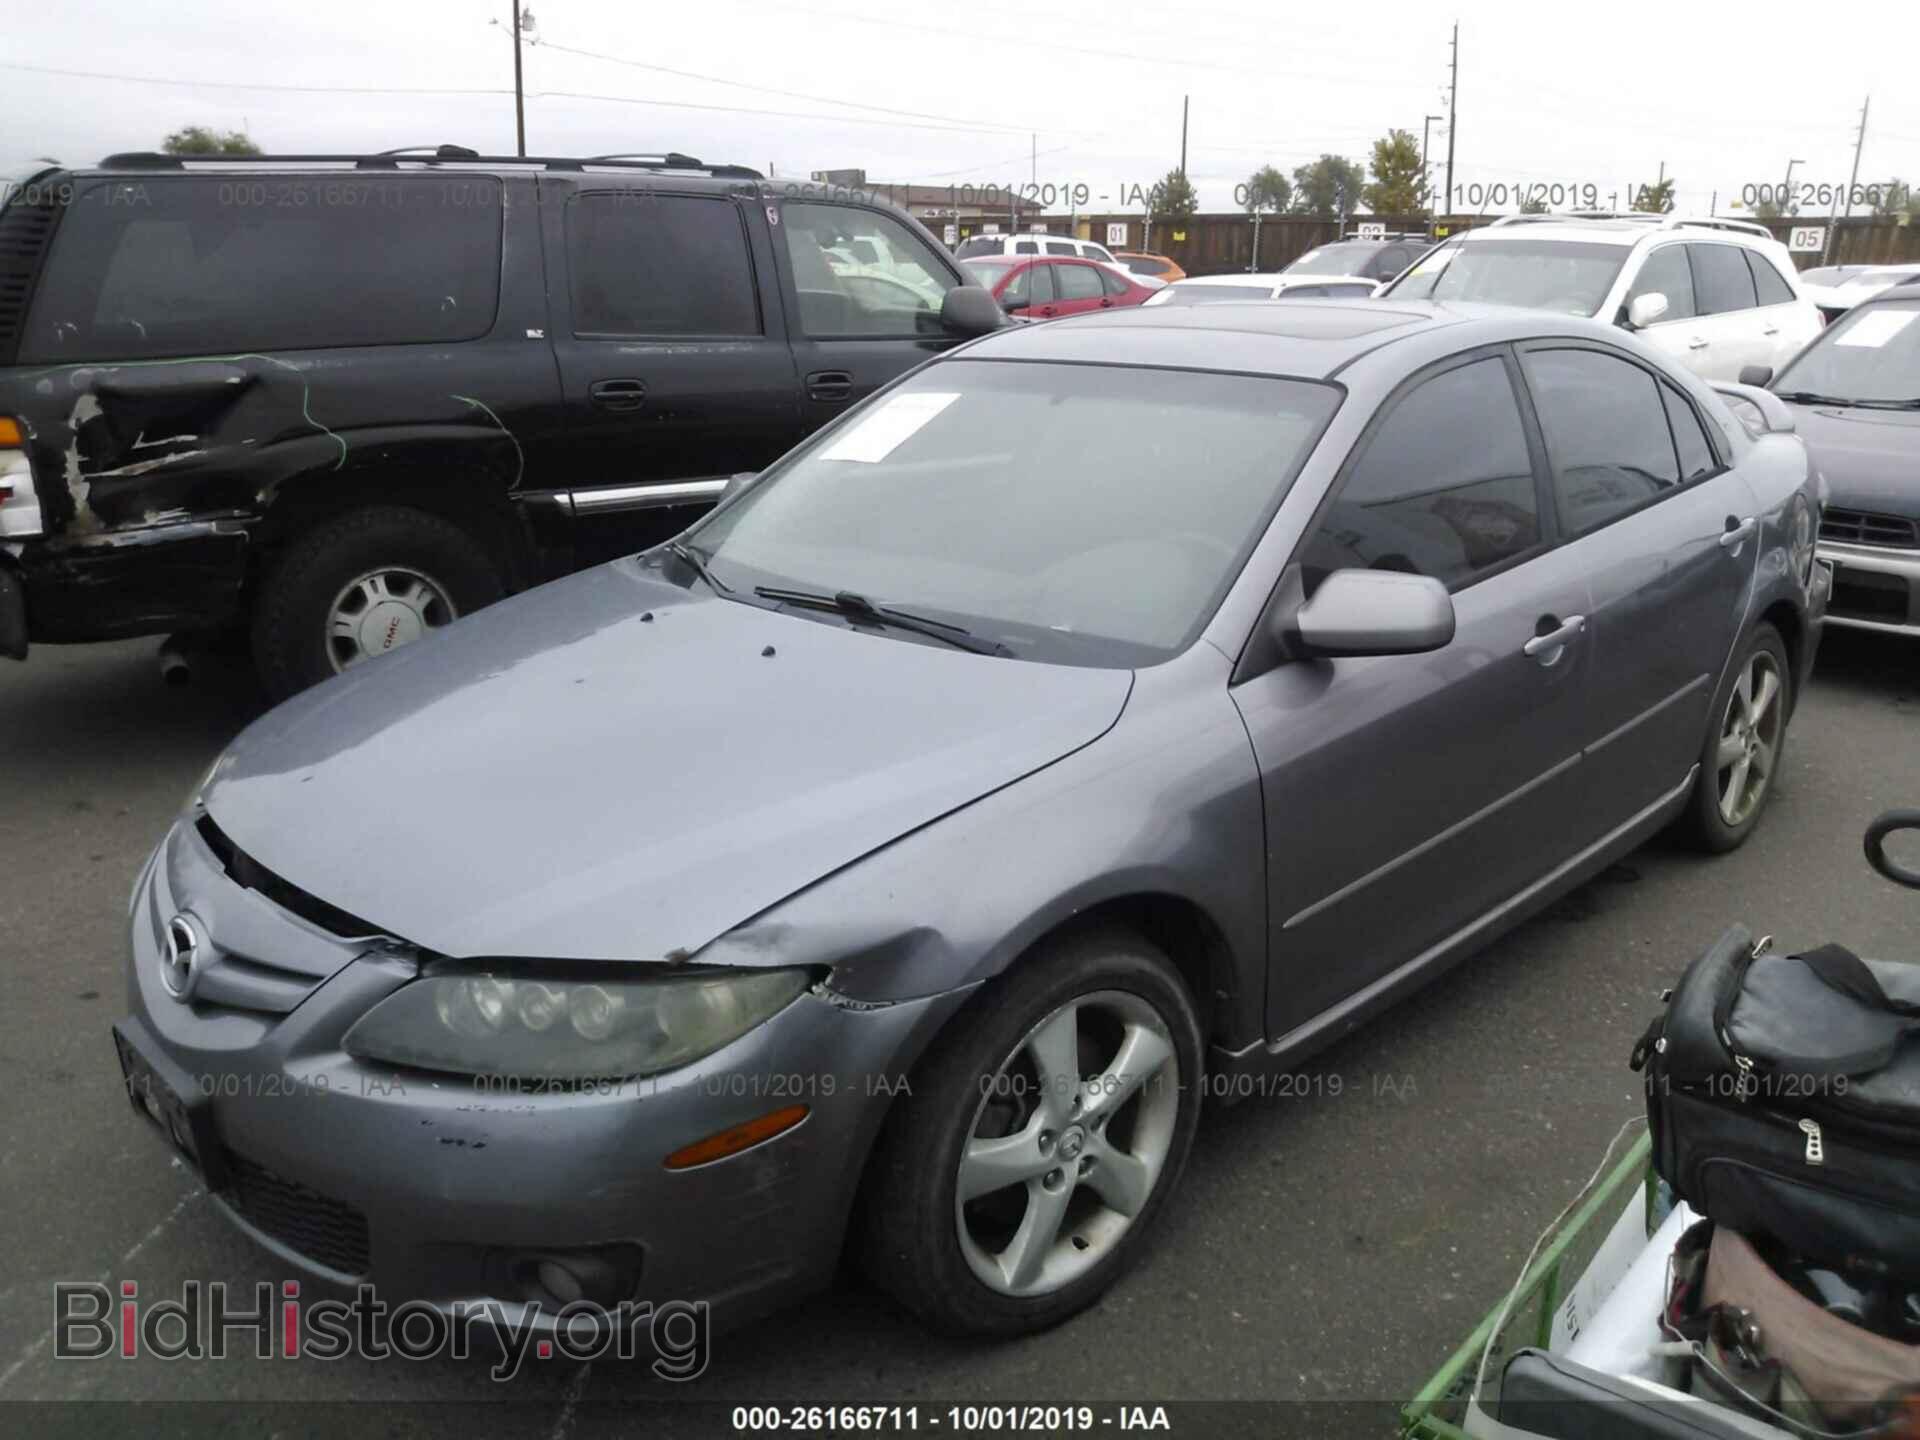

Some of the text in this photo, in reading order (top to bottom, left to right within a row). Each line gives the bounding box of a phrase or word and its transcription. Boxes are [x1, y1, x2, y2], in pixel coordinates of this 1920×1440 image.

[1110, 224, 1124, 241] 01
[1795, 230, 1820, 248] 05
[384, 616, 400, 649] GMC
